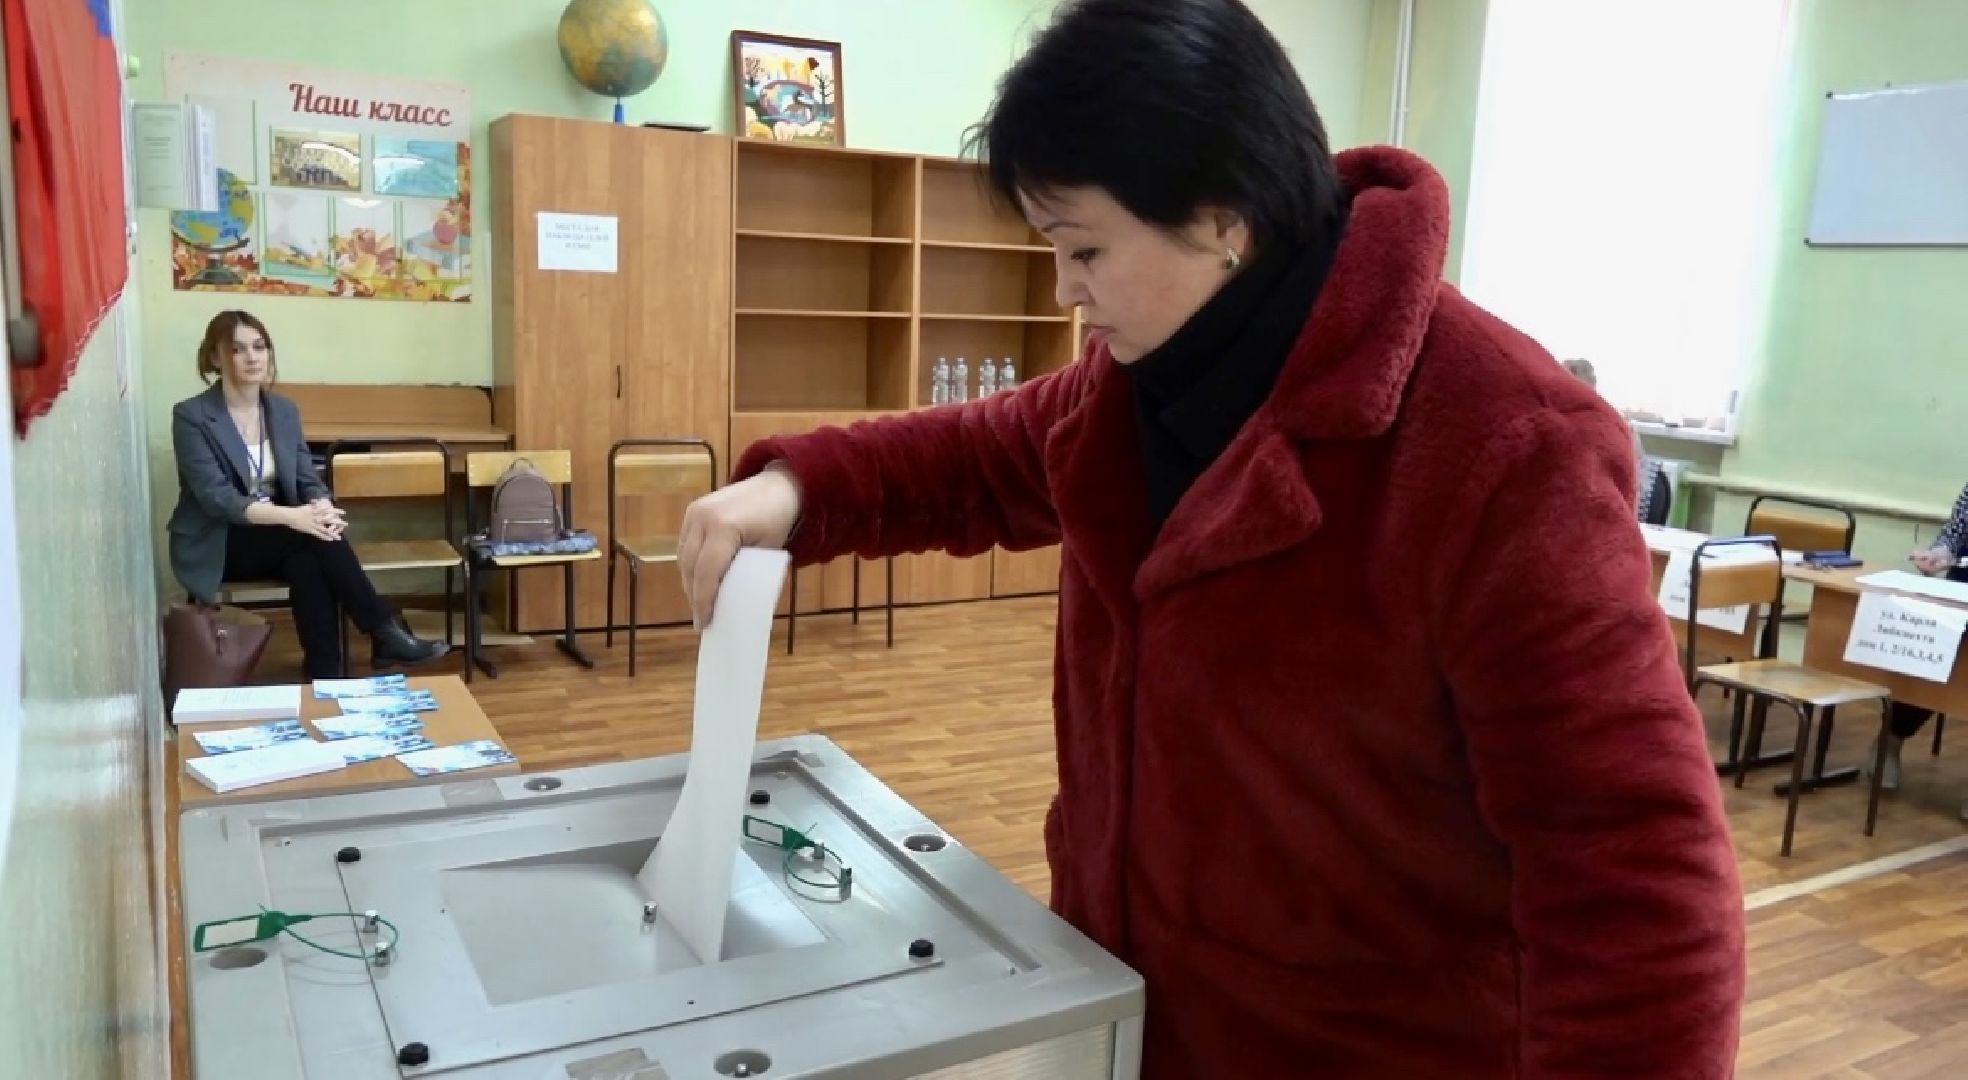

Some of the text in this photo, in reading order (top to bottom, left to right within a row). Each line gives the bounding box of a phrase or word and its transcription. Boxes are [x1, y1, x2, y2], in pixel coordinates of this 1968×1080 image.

[289, 83, 453, 127] Наш класс
[1900, 611, 1937, 628] Карла
